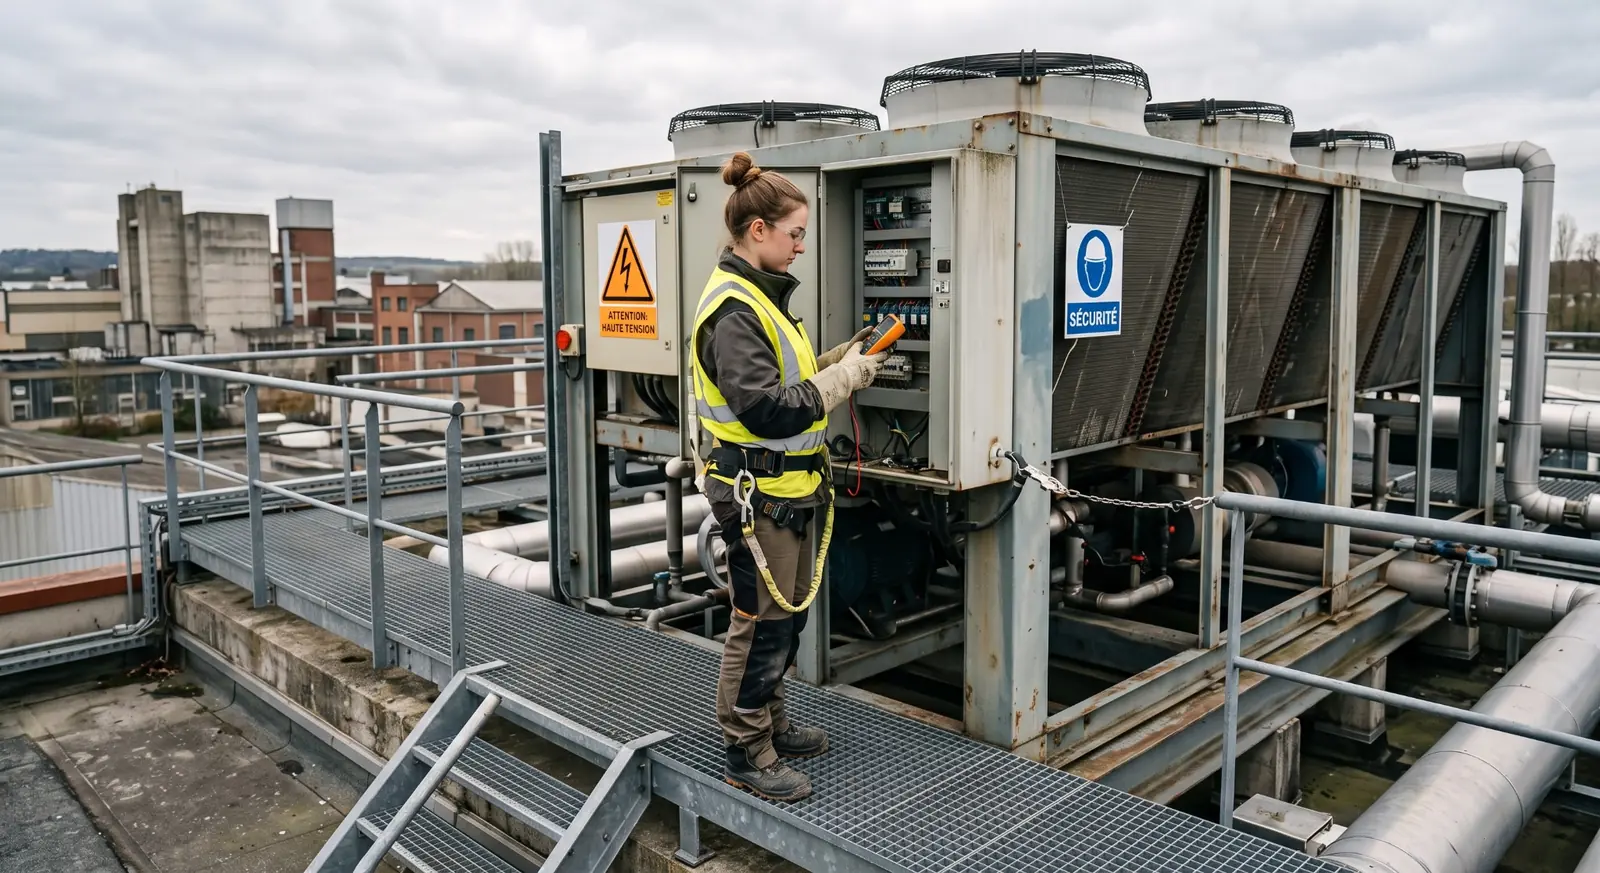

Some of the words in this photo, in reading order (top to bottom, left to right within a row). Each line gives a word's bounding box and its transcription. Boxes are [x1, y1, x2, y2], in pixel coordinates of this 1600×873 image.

[608, 311, 648, 321] ATTENTION:
[1069, 306, 1118, 327] SÉCURITÉ
[602, 324, 623, 333] HAUTE
[625, 324, 655, 334] TENSION
